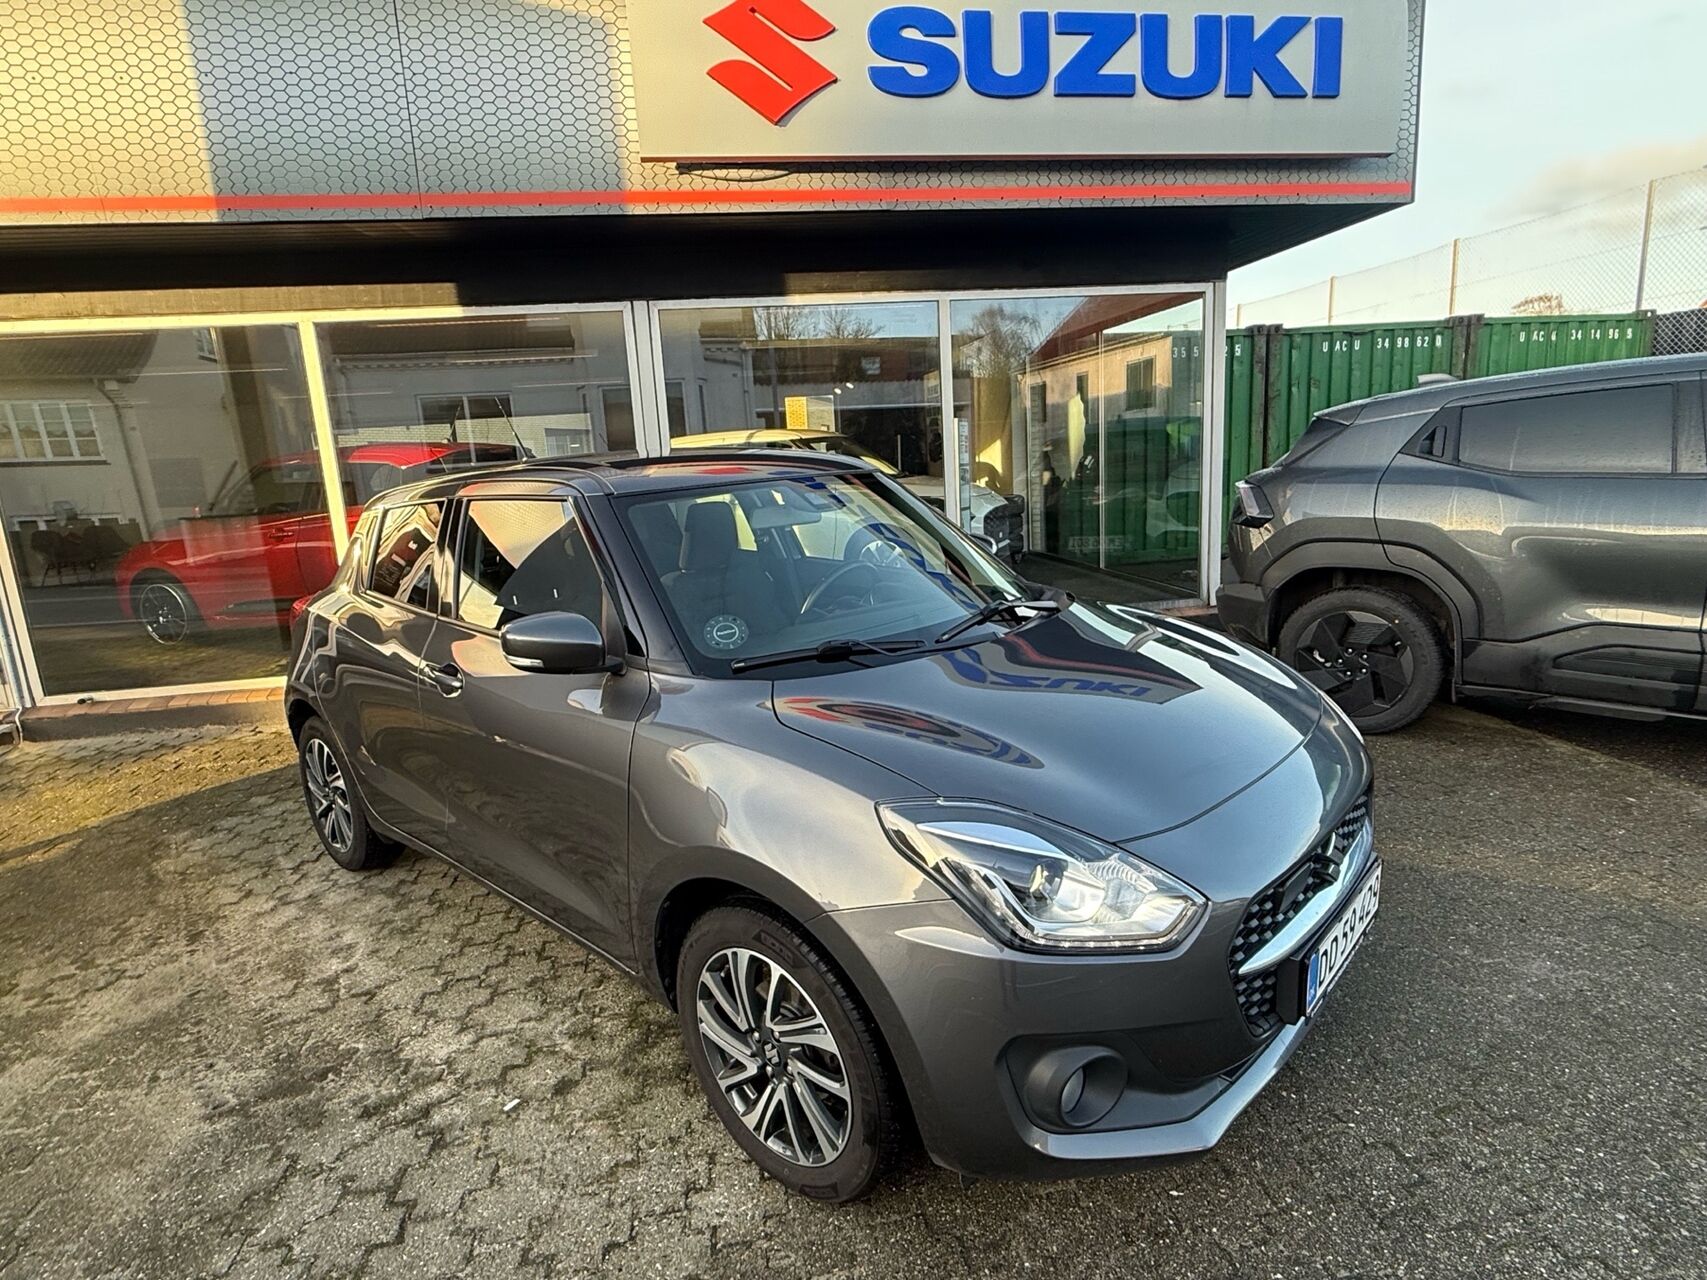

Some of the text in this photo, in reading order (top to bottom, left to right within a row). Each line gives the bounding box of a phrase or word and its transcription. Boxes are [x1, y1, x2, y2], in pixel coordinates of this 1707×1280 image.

[868, 6, 1343, 100] SUZUKI
[1318, 934, 1339, 988] DD
[1340, 906, 1357, 955] 59
